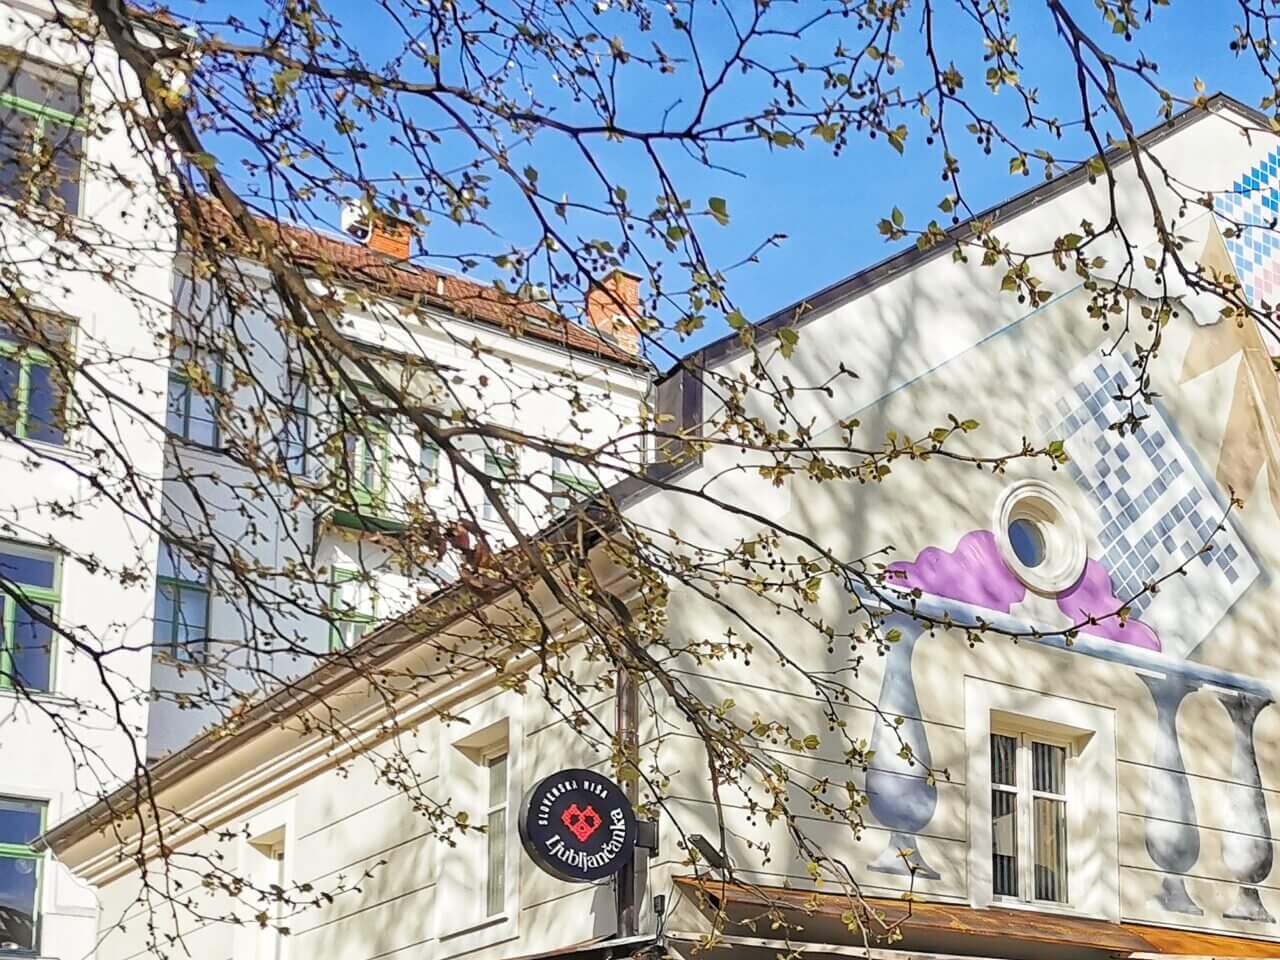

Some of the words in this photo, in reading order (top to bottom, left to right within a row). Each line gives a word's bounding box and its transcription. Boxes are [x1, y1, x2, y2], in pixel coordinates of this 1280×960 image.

[538, 780, 578, 825] SLOVENSKA
[583, 780, 608, 799] HIŠA
[545, 807, 626, 872] Ljubljančanka
